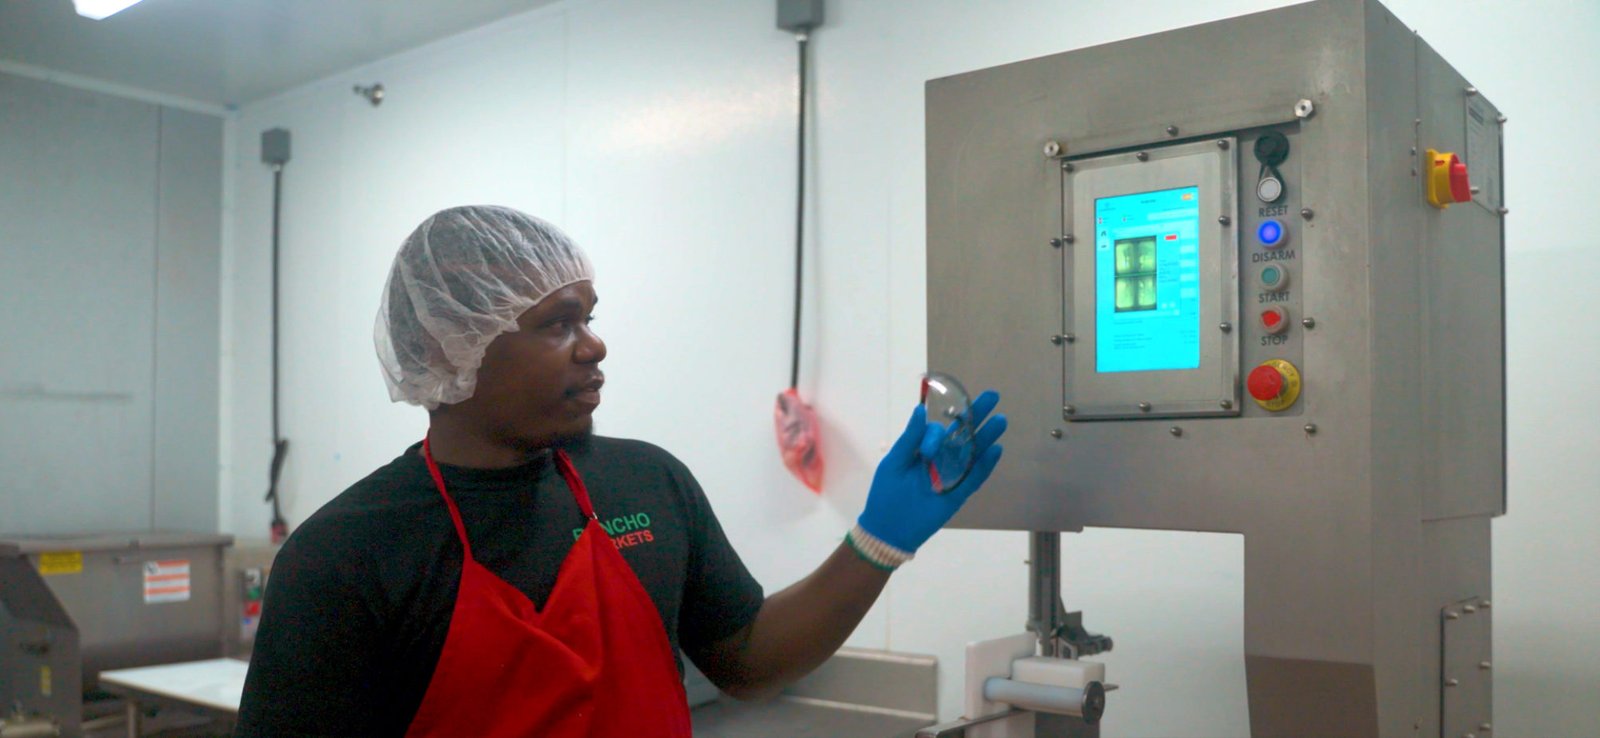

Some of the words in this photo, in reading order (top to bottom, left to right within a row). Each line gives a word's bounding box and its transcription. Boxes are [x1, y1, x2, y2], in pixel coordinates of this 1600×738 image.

[1258, 204, 1289, 218] RESET
[1252, 249, 1296, 263] DISARM
[1258, 291, 1290, 304] START
[1260, 334, 1289, 346] STOP
[572, 512, 650, 541] NCHO
